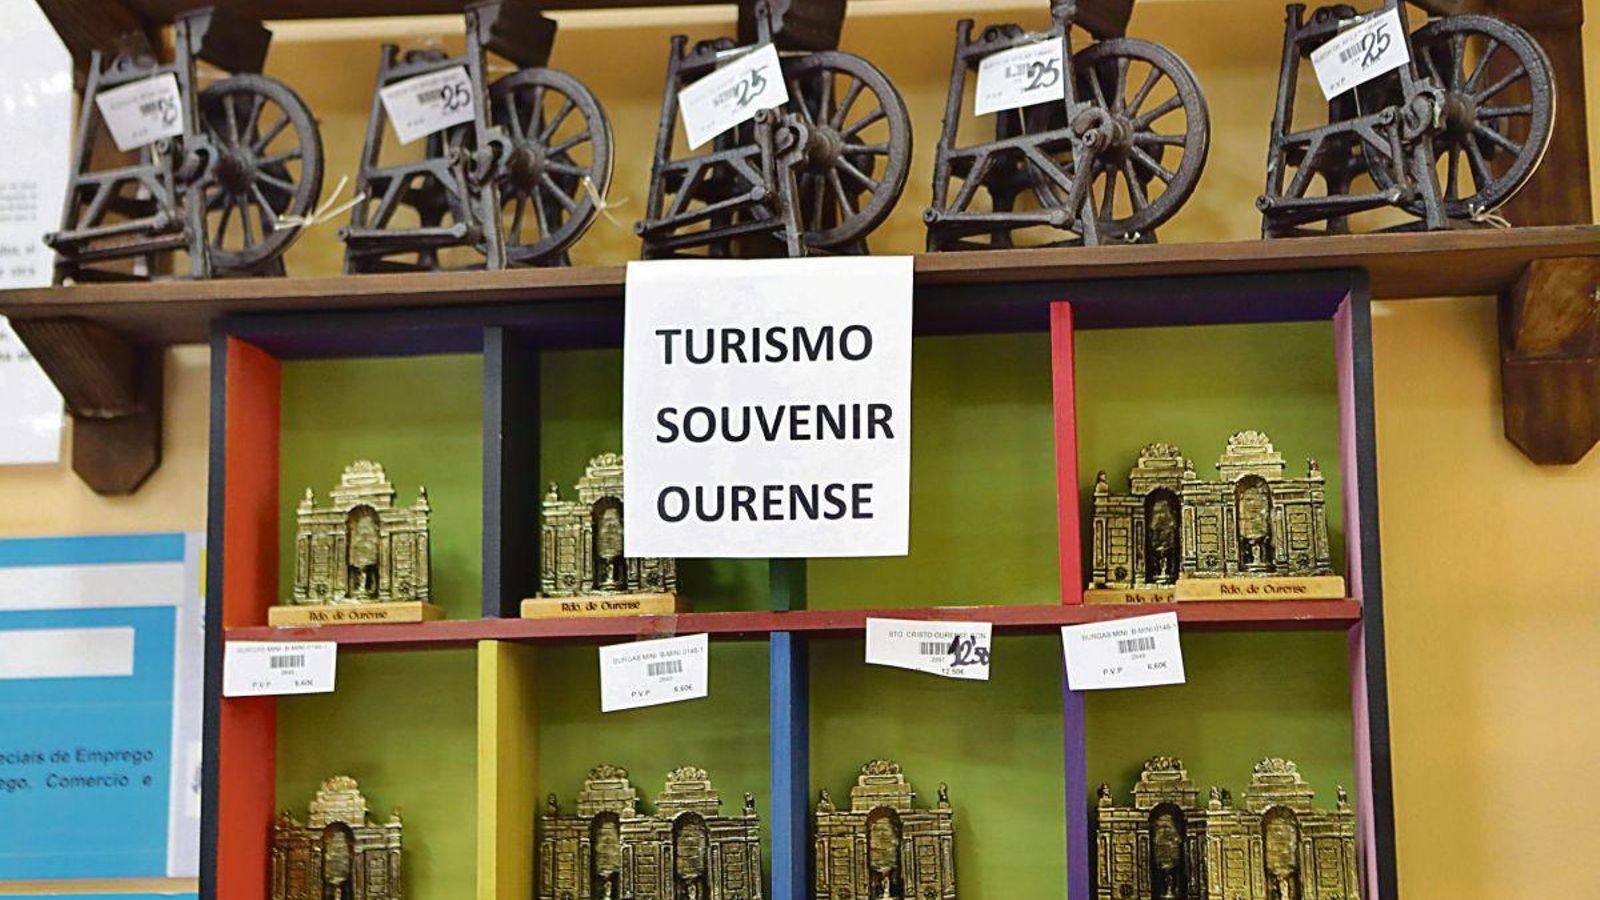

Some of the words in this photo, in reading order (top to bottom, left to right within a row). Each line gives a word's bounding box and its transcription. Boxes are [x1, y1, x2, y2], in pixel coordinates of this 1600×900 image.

[1361, 22, 1391, 67] 25
[735, 65, 768, 107] 25
[1024, 58, 1060, 92] 25
[441, 82, 471, 110] 25
[655, 324, 873, 364] TURISMO
[656, 403, 895, 443] SOUVENIR
[657, 483, 874, 522] OURENSE
[1246, 583, 1260, 594] de
[1263, 584, 1307, 594] Ourense
[332, 611, 346, 619] de
[348, 610, 388, 619] Ourense
[585, 601, 598, 611] de
[600, 601, 641, 611] Ourense
[49, 750, 71, 764] de
[75, 747, 154, 766] Emprego
[46, 773, 129, 789] Comercio
[142, 774, 153, 785] e
